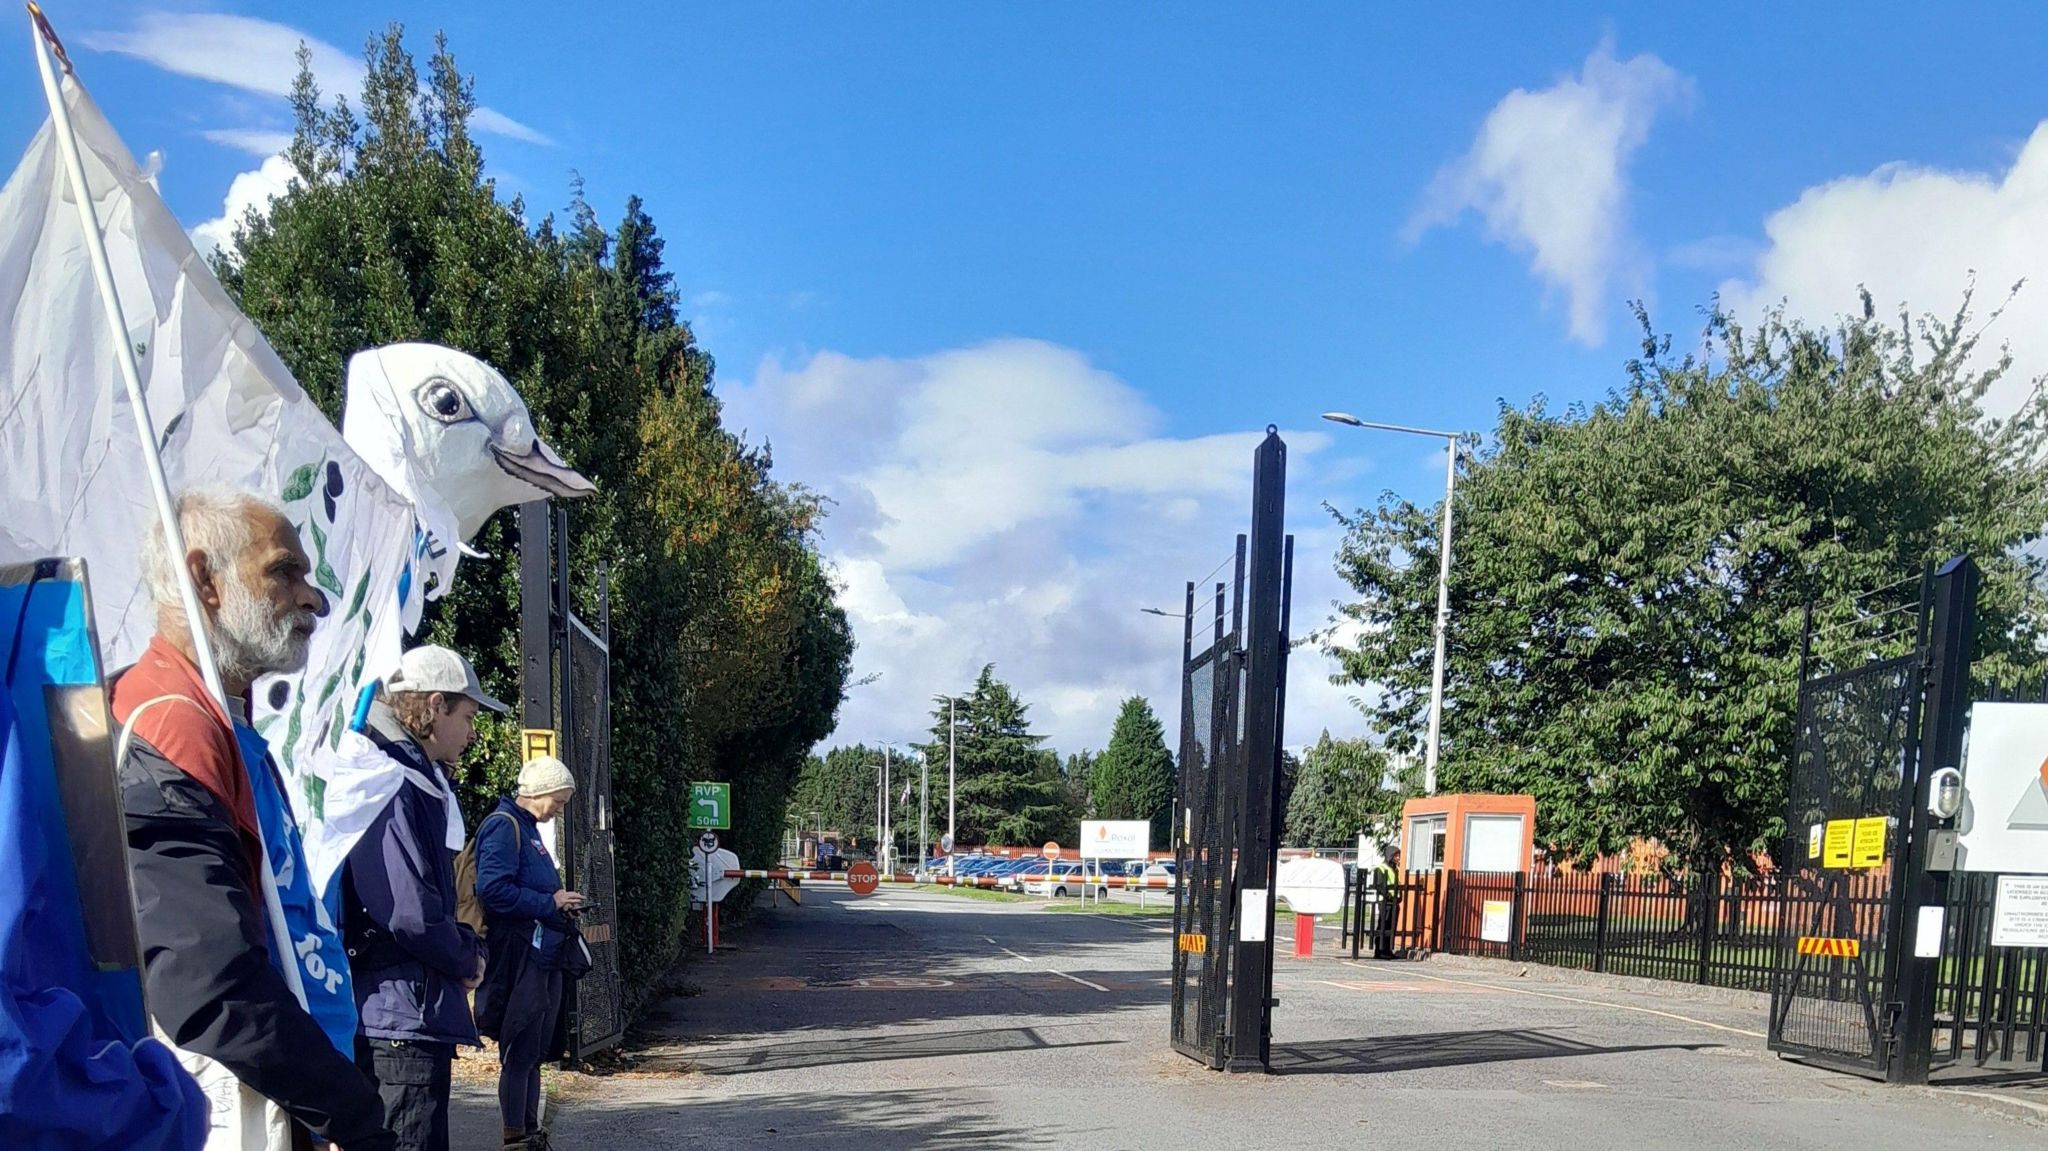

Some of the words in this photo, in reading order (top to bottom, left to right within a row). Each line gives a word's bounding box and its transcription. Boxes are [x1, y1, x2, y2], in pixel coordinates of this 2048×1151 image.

[694, 785, 721, 796] RVP
[696, 816, 720, 826] 50m
[850, 874, 877, 883] STOP
